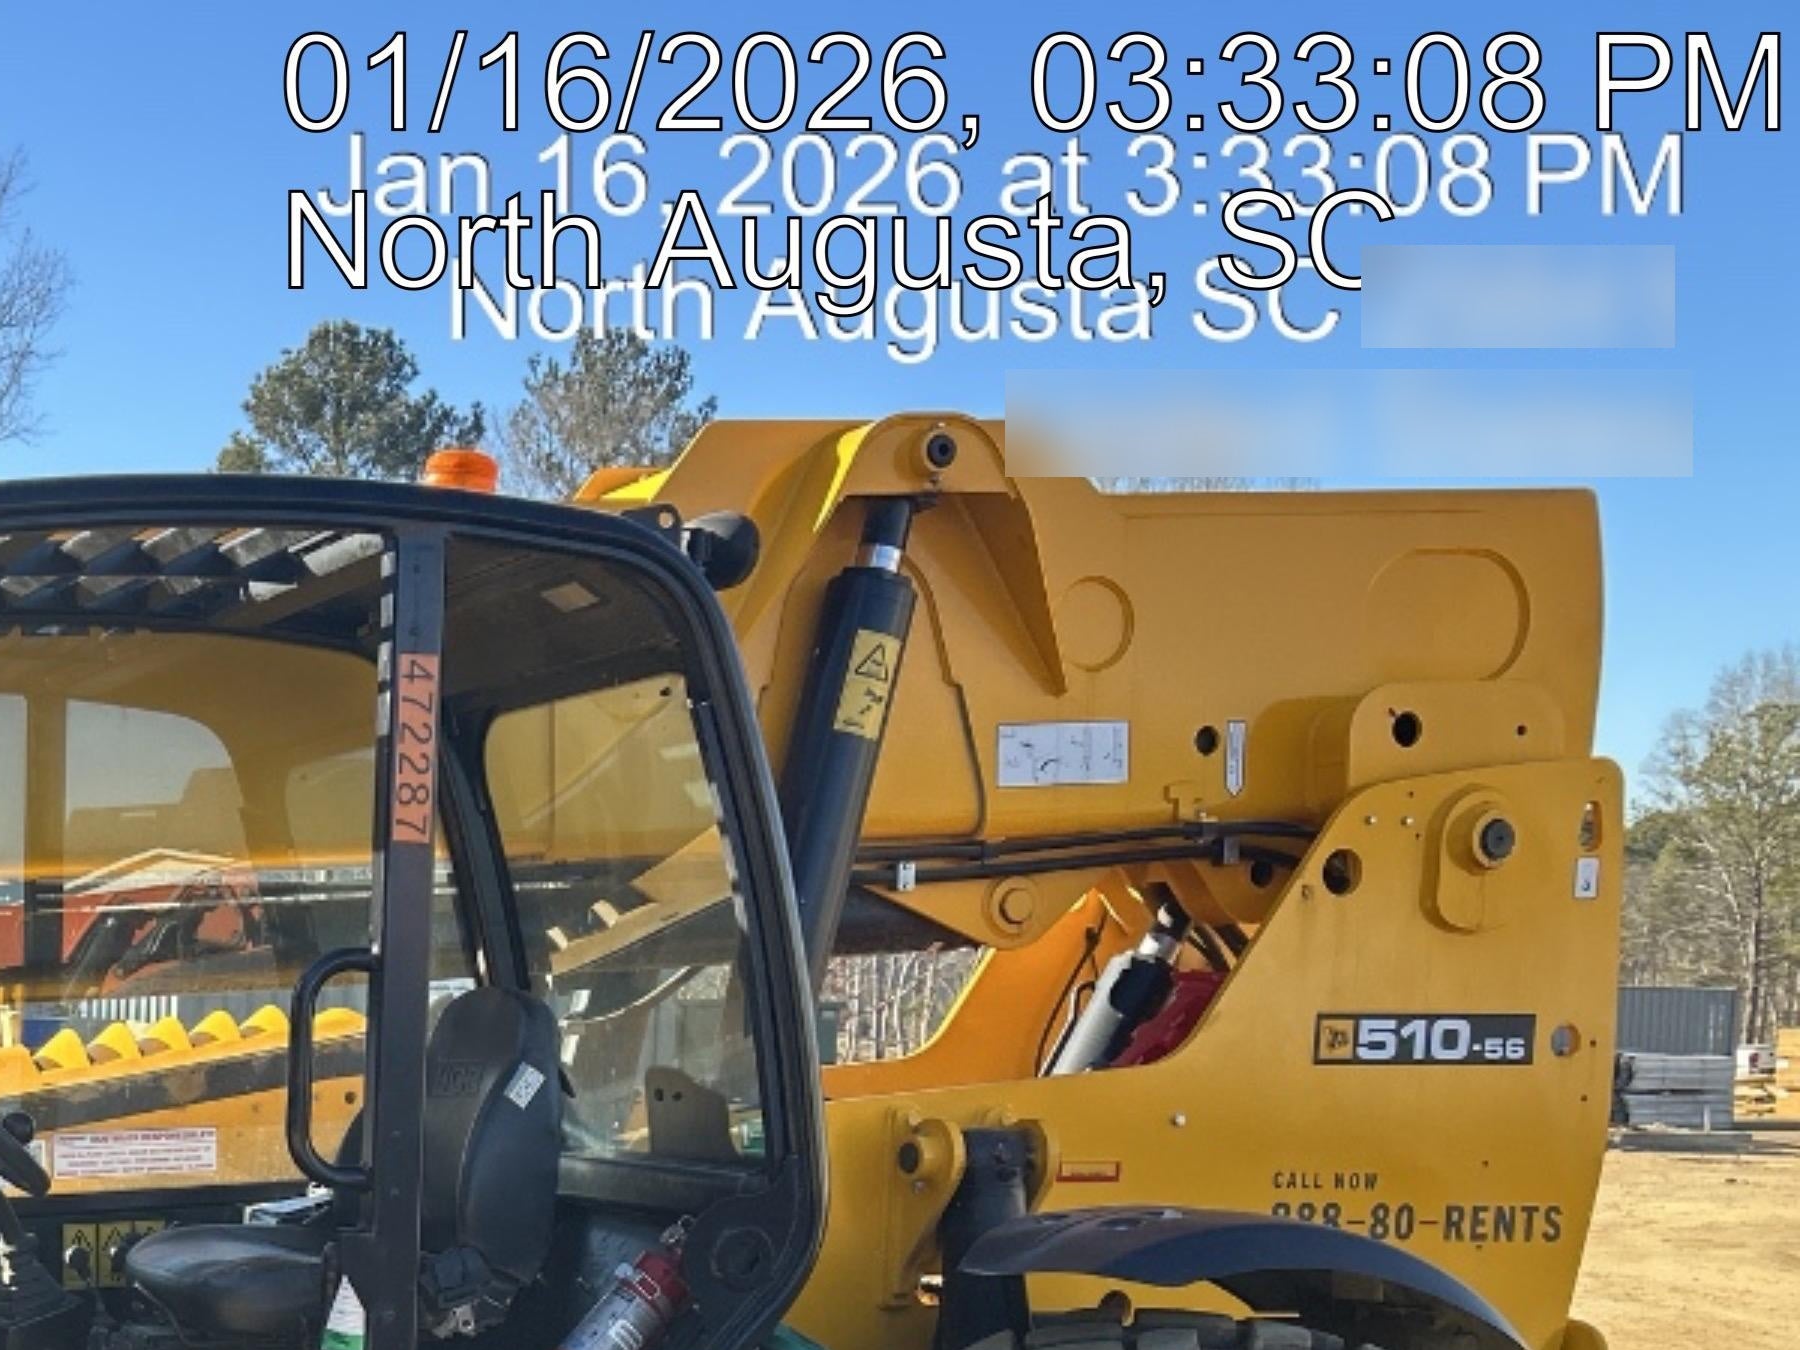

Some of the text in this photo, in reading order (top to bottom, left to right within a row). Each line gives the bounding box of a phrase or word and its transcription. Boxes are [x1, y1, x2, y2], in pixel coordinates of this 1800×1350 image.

[395, 660, 434, 835] 472287
[1356, 1018, 1525, 1061] 510-56
[1272, 1172, 1379, 1189] CALL NOW
